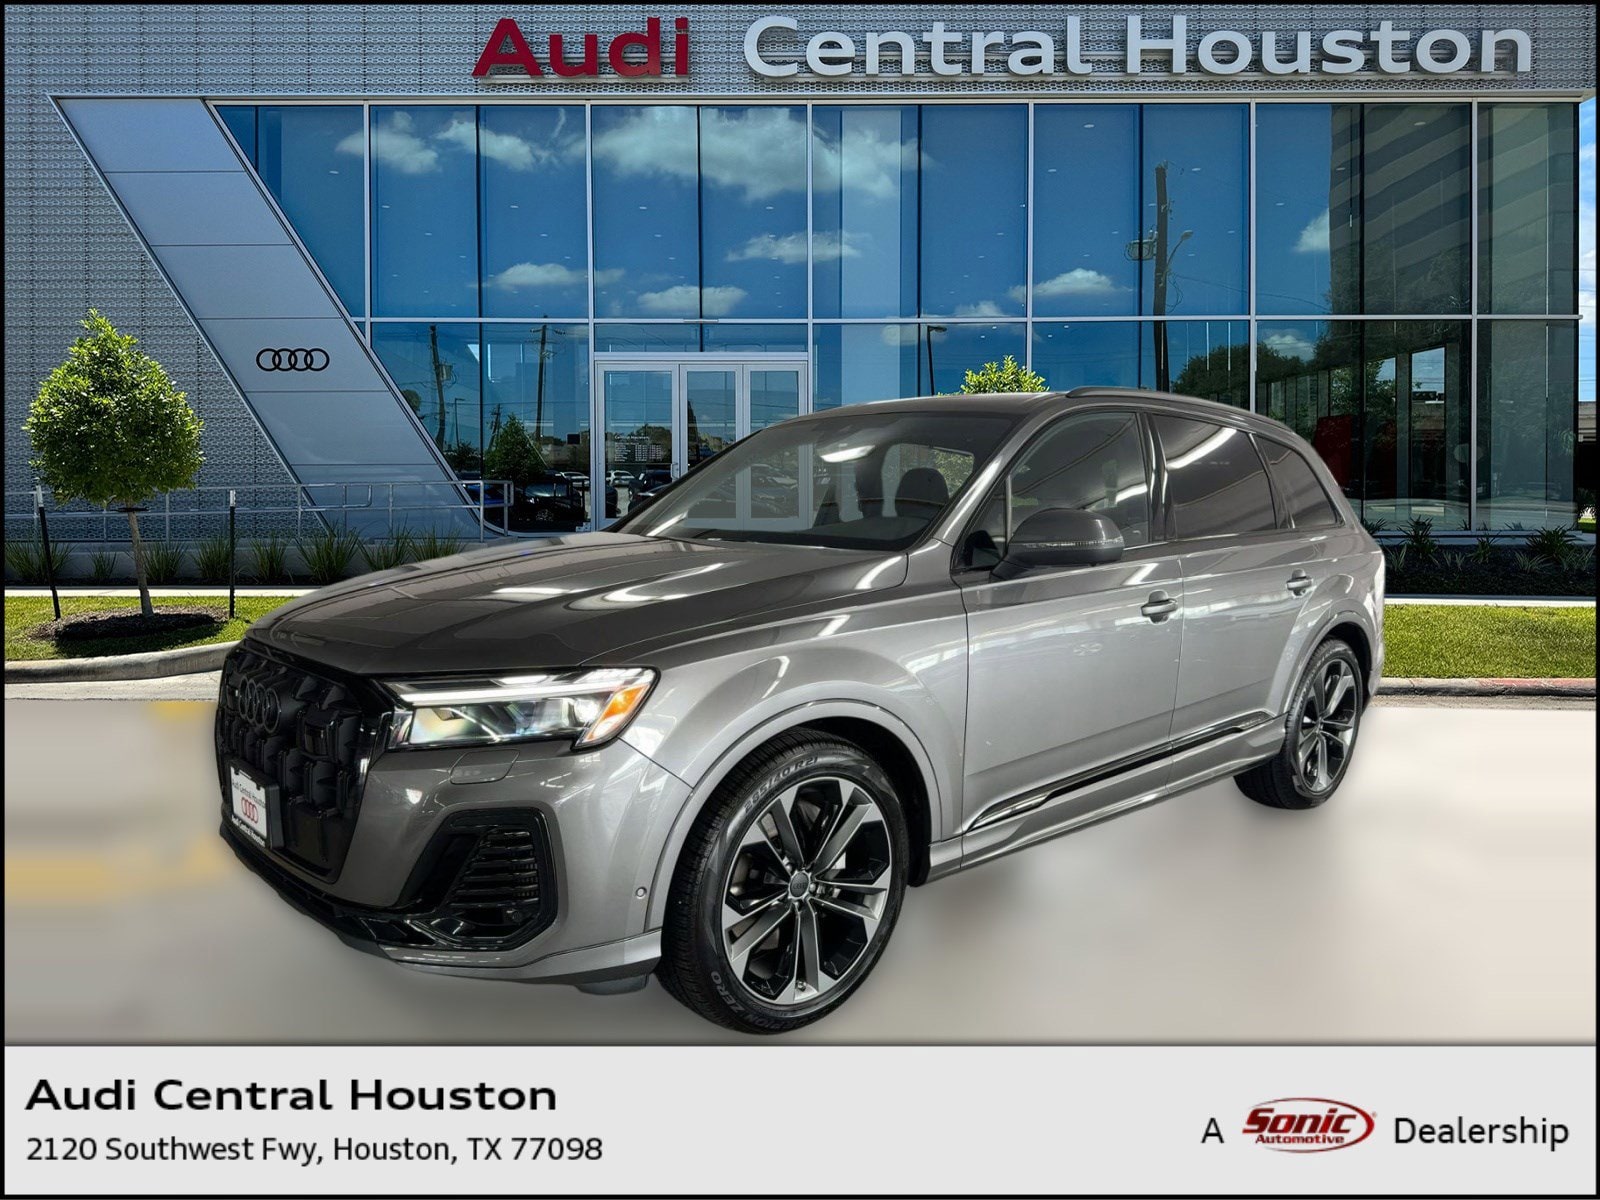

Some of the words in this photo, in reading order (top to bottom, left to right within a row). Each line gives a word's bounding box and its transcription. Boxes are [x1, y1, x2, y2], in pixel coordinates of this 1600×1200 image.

[472, 17, 690, 77] Audi
[743, 15, 1092, 77] Central
[1126, 15, 1532, 76] Houston
[710, 970, 745, 1013] ZERO
